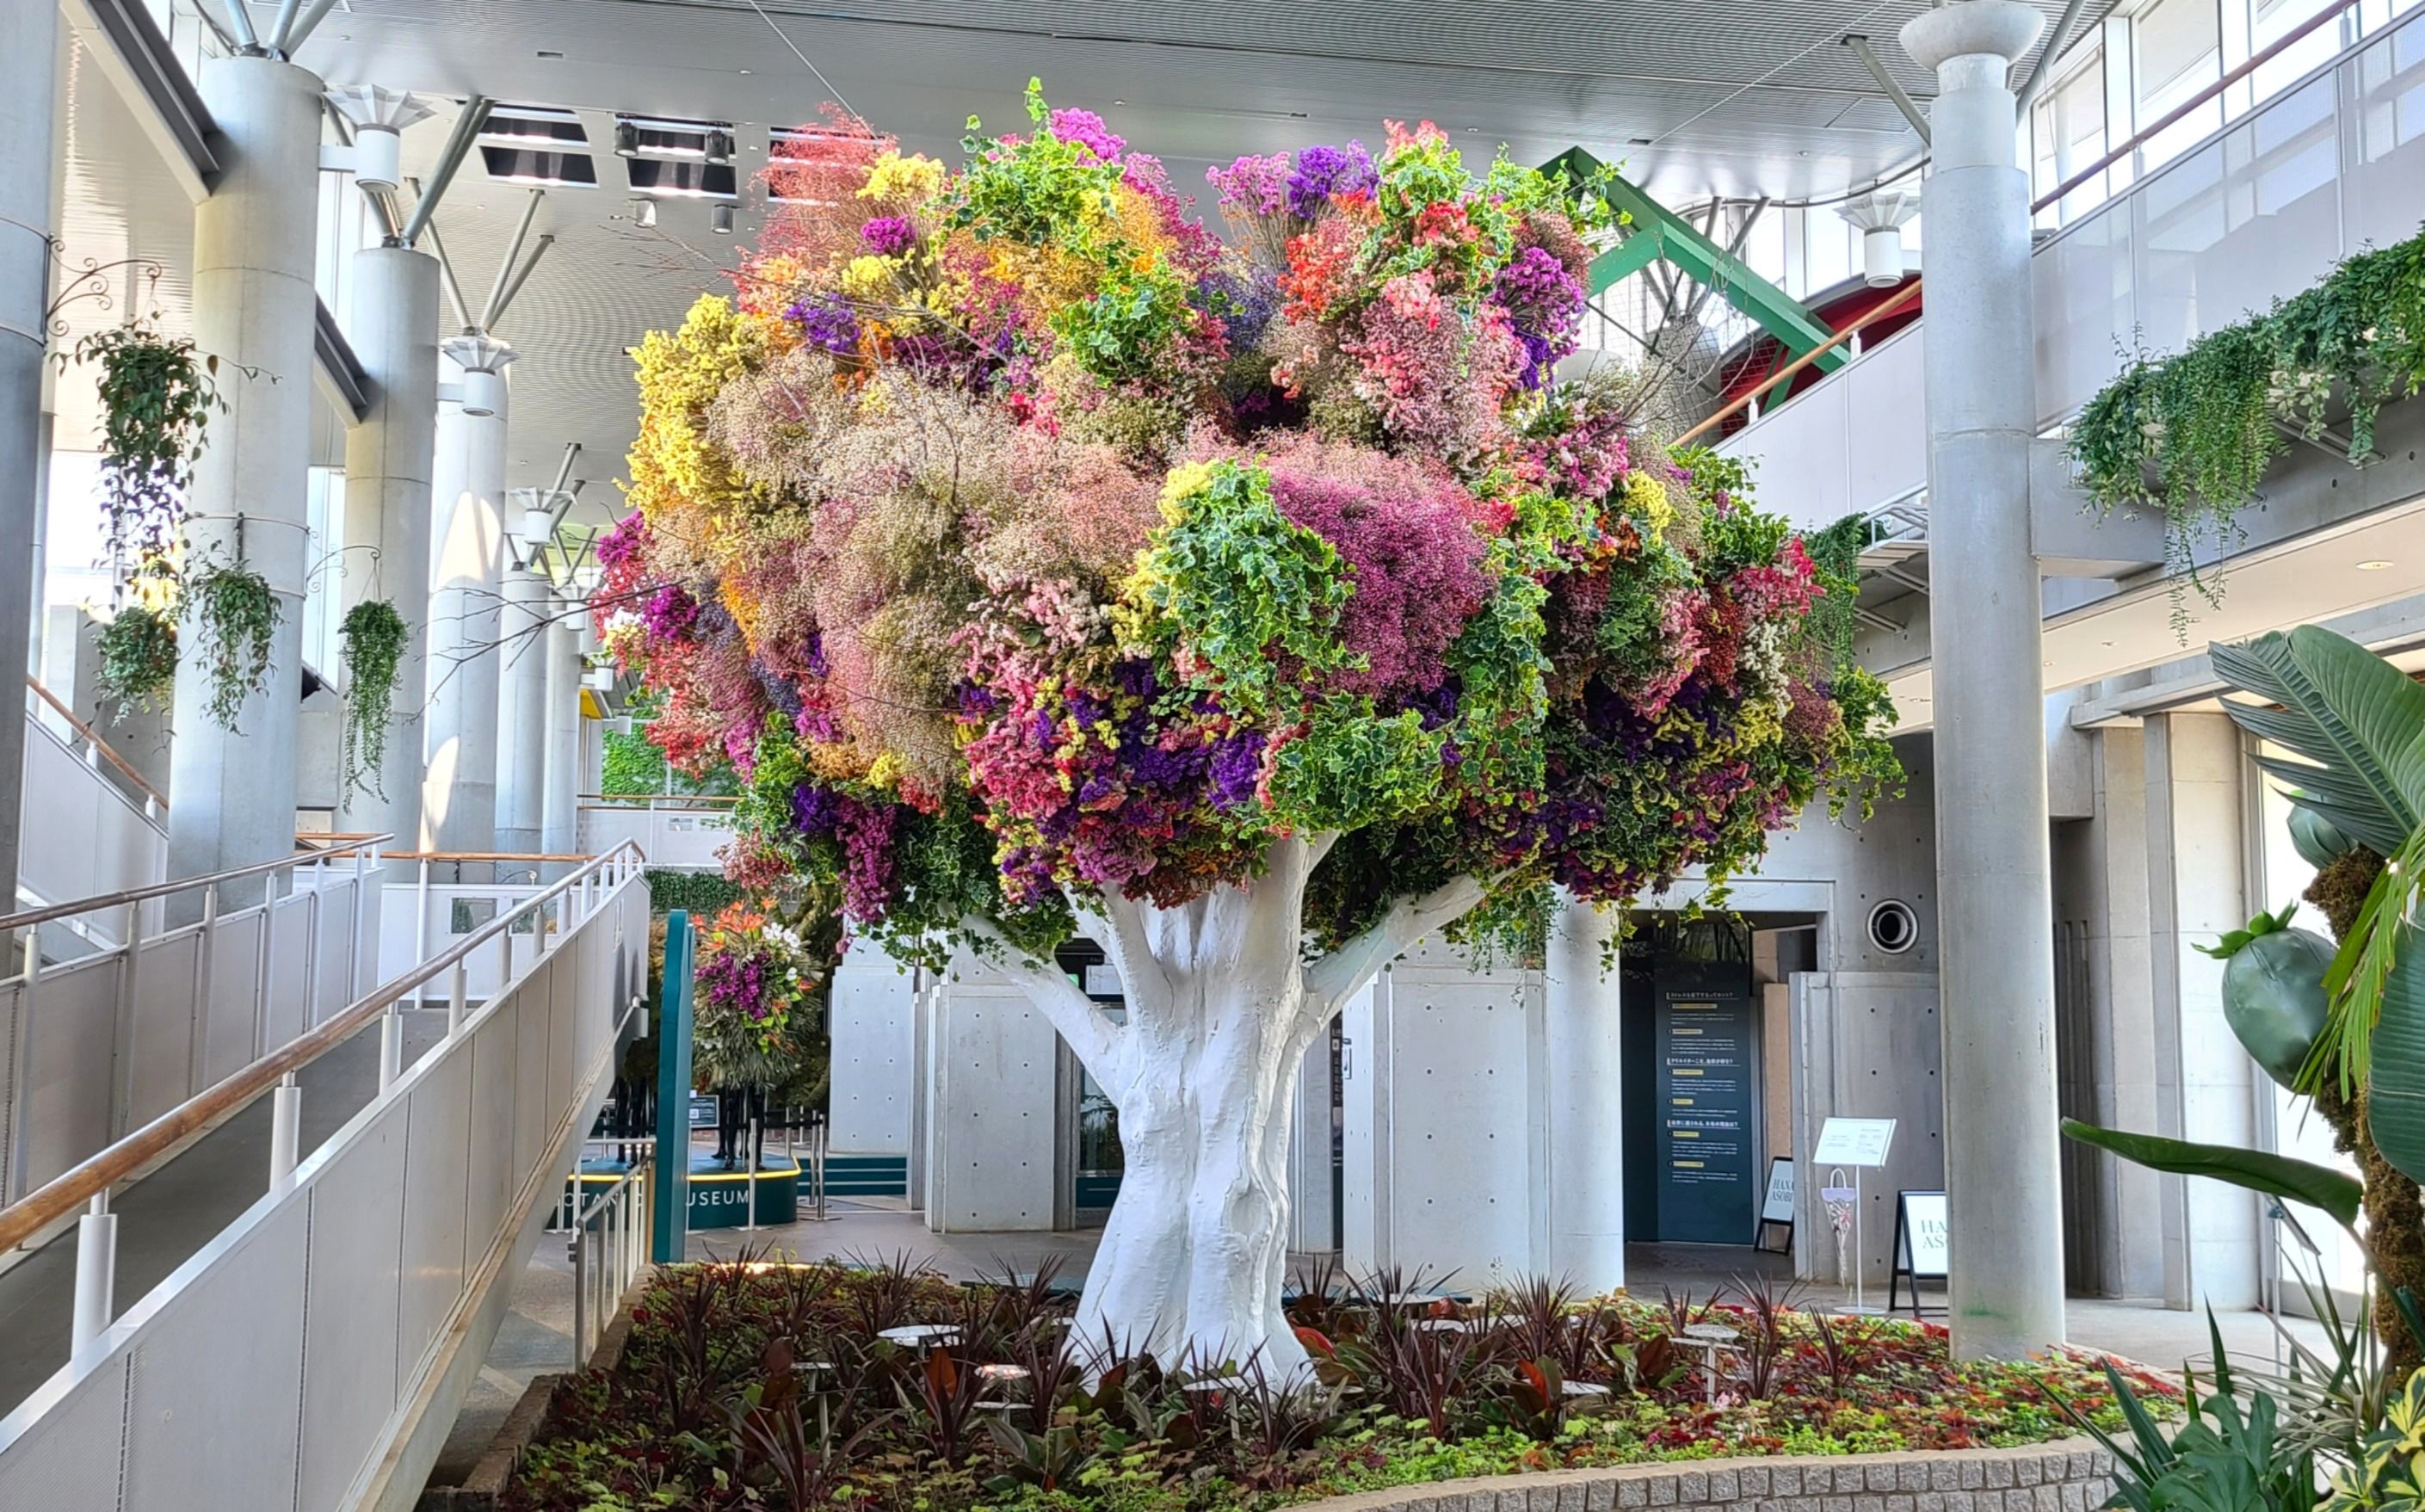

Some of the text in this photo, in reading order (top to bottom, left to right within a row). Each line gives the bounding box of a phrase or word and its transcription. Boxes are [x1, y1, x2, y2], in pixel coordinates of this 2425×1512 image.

[685, 1189, 749, 1207] USEUM
[1921, 1219, 1947, 1233] HA
[1922, 1235, 1947, 1249] AS
